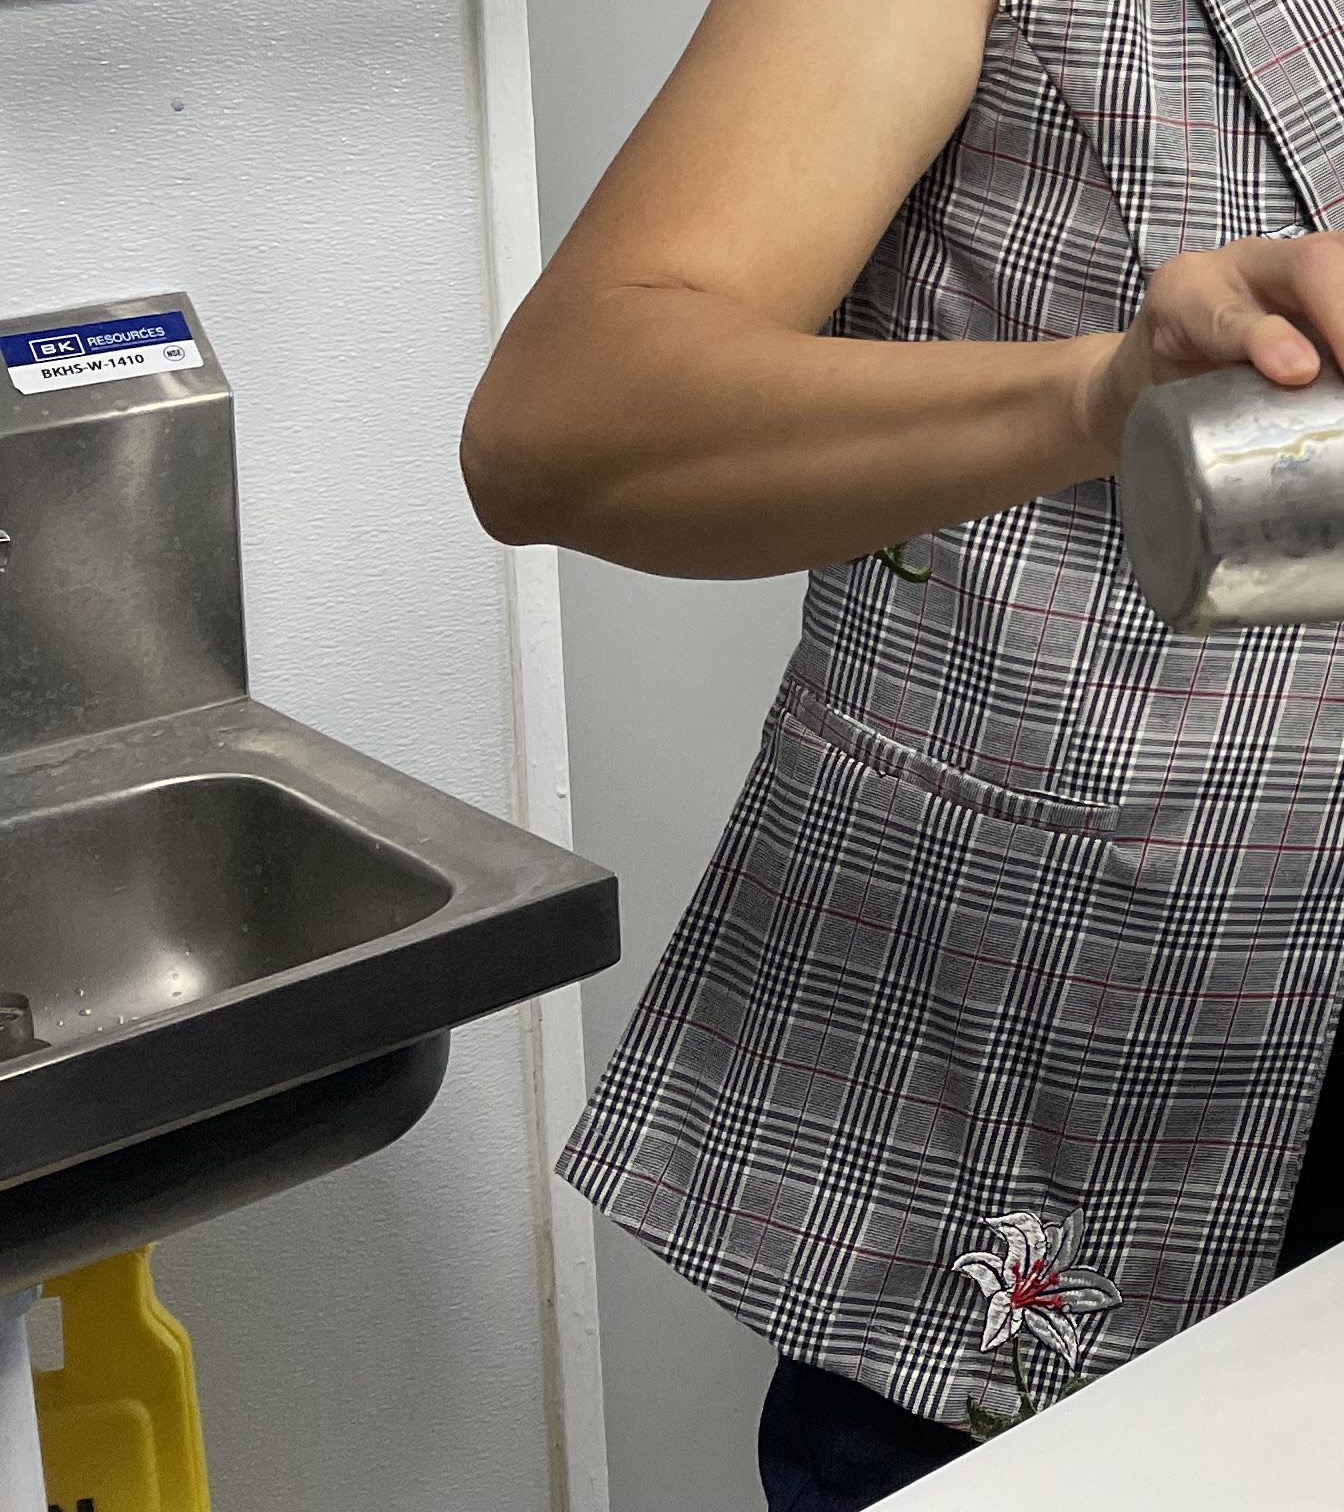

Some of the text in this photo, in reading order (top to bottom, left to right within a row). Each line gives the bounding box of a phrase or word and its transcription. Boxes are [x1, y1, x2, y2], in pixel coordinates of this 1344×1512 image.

[40, 326, 166, 356] BK RESOURCES
[41, 353, 145, 380] BKHS-W-1410
